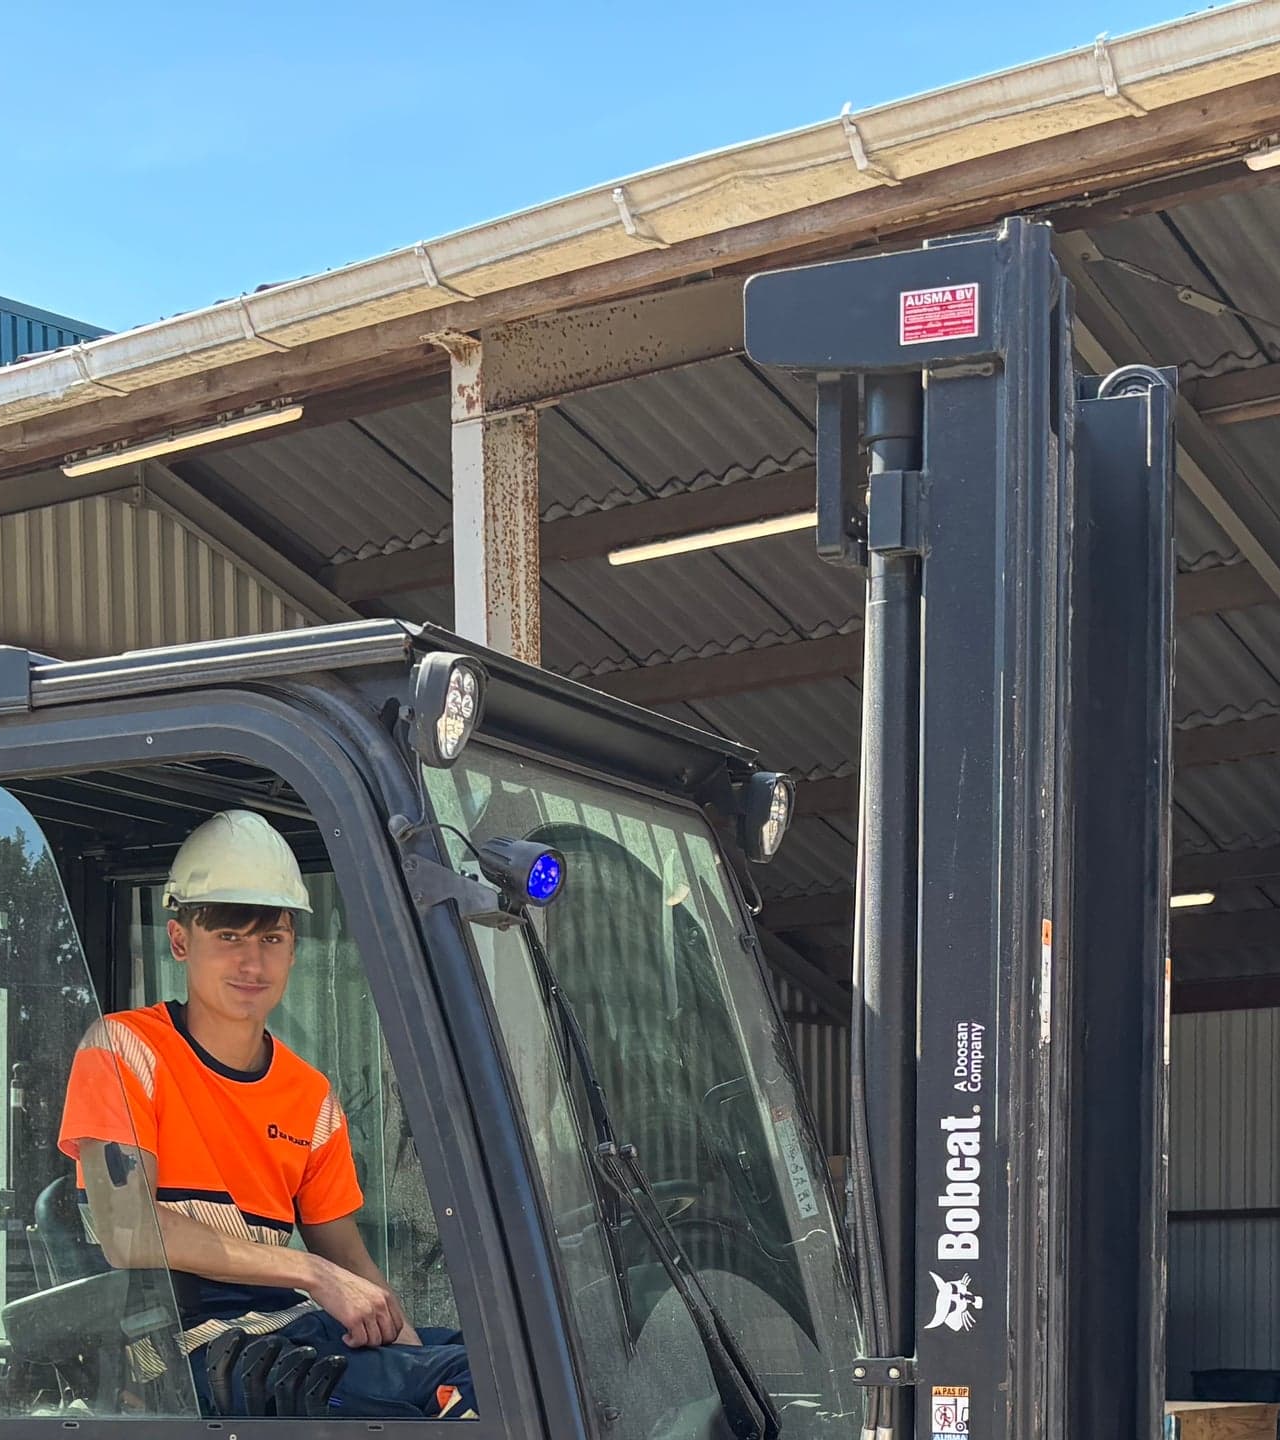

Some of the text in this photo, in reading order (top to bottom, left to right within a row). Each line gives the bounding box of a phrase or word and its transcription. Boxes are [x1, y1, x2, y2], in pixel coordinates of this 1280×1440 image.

[906, 288, 973, 306] AUSMA BV
[954, 1022, 968, 1092] A Doosan
[967, 1022, 985, 1092] Company
